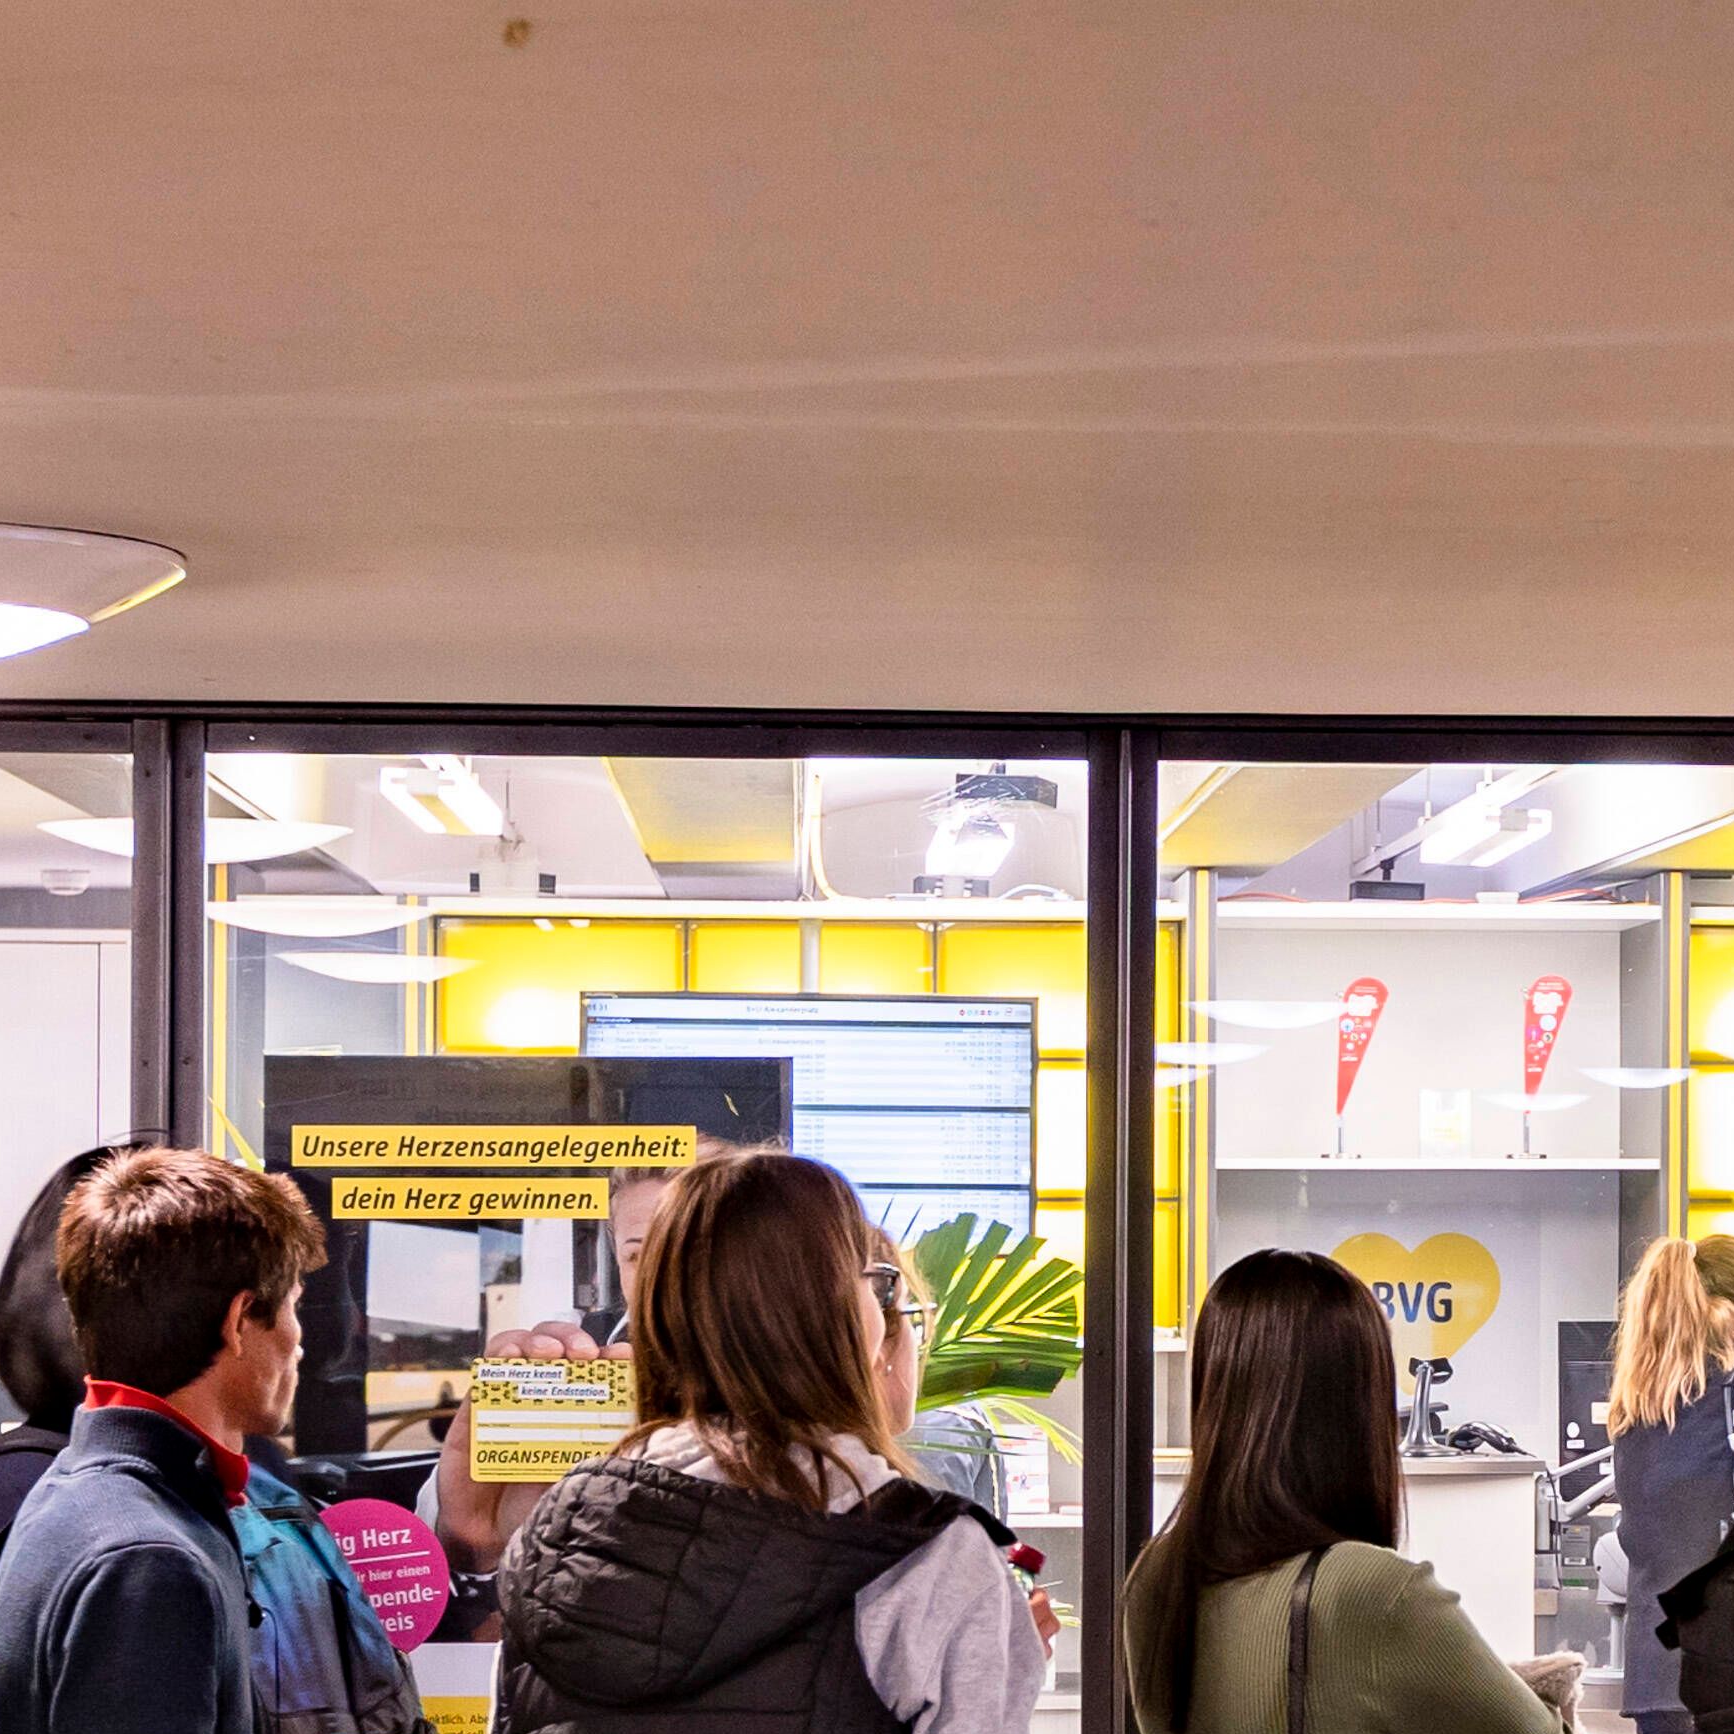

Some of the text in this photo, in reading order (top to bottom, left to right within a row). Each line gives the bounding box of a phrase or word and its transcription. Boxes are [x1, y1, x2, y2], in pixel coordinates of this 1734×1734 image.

[302, 1134, 688, 1164] Unsere Herzensangelegenheit:
[342, 1186, 599, 1216] dein Herz gewinnen.
[1370, 1281, 1453, 1324] BVG
[480, 1367, 563, 1380] Mein Herz kennt
[521, 1385, 608, 1399] keine Endstation.
[476, 1448, 605, 1464] ORGANSPENDE
[361, 1527, 413, 1549] Herz
[368, 1568, 393, 1582] hier
[395, 1565, 431, 1578] einen
